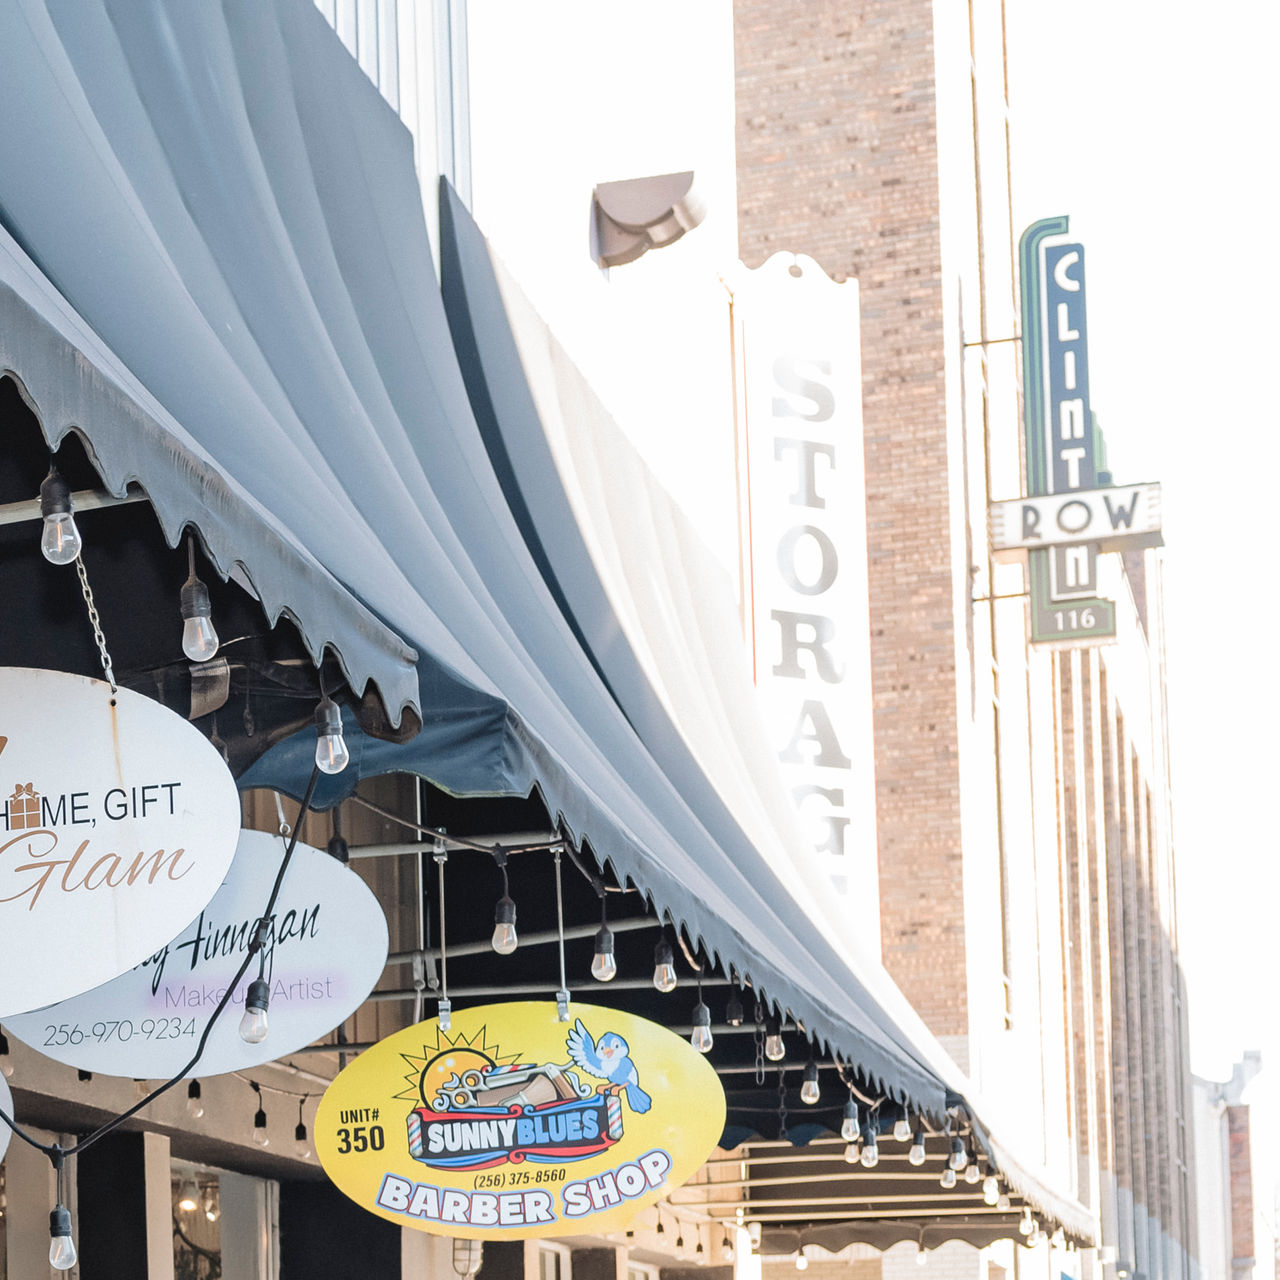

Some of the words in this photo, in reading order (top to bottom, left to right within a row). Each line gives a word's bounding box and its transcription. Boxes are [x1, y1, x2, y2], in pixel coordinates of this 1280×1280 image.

[1020, 491, 1140, 541] ROW
[770, 355, 852, 895] STORAG
[1054, 607, 1096, 632] 116
[103, 782, 182, 824] GIFT
[164, 986, 248, 1009] Makeu
[272, 977, 333, 1001] Artist
[43, 1016, 197, 1047] 256-970-9234
[340, 1107, 380, 1125] UNIT#
[336, 1125, 386, 1155] 350
[377, 1174, 556, 1226] BARBER
[563, 1149, 672, 1217] SHOP
[472, 1174, 507, 1190] (256)
[508, 1168, 567, 1188] 375-8560
